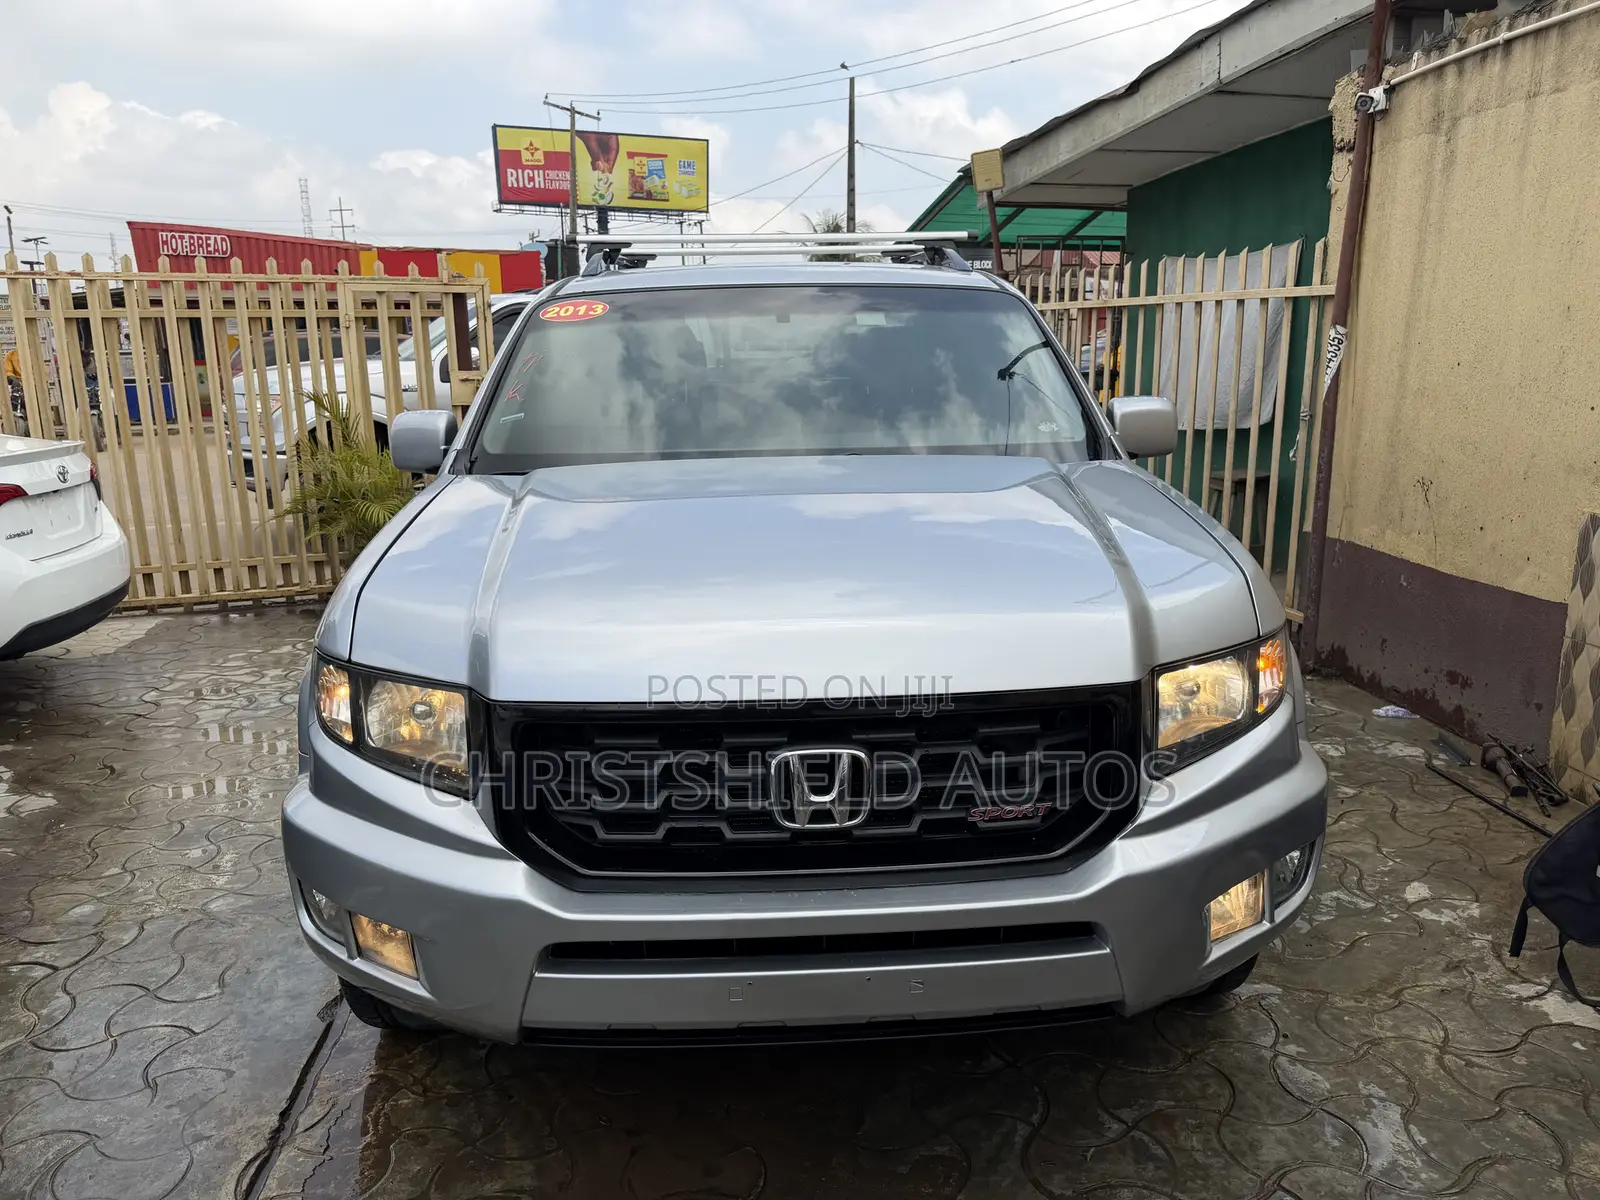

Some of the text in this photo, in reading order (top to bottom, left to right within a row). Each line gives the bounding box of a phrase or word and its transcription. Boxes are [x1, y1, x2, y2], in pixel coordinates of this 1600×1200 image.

[507, 168, 545, 189] RICH
[973, 260, 993, 269] BLOCK
[543, 304, 604, 318] 2013
[968, 802, 1053, 822] SPORT
